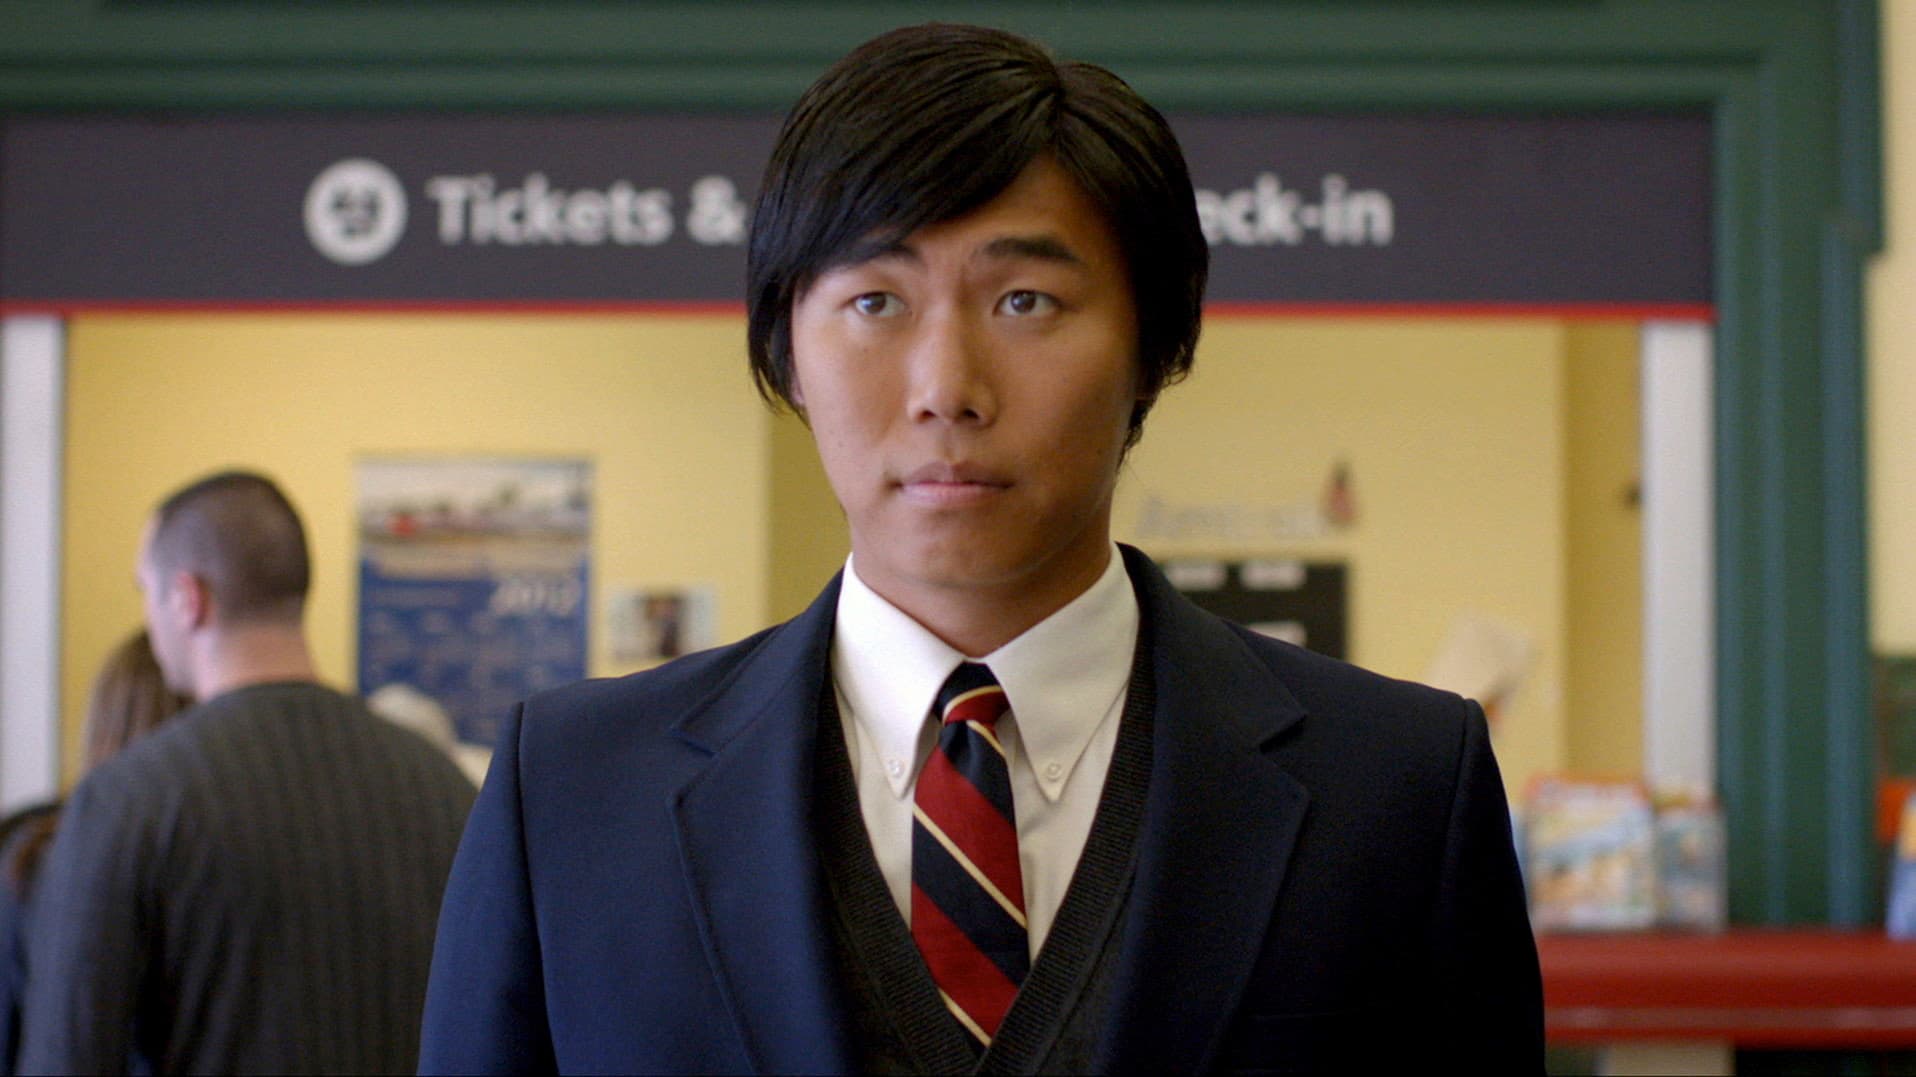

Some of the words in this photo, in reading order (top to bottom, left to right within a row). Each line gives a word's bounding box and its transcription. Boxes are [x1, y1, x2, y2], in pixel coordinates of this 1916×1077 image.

[427, 174, 673, 244] Tickets
[687, 175, 746, 245] &
[1195, 173, 1394, 245] eck-in
